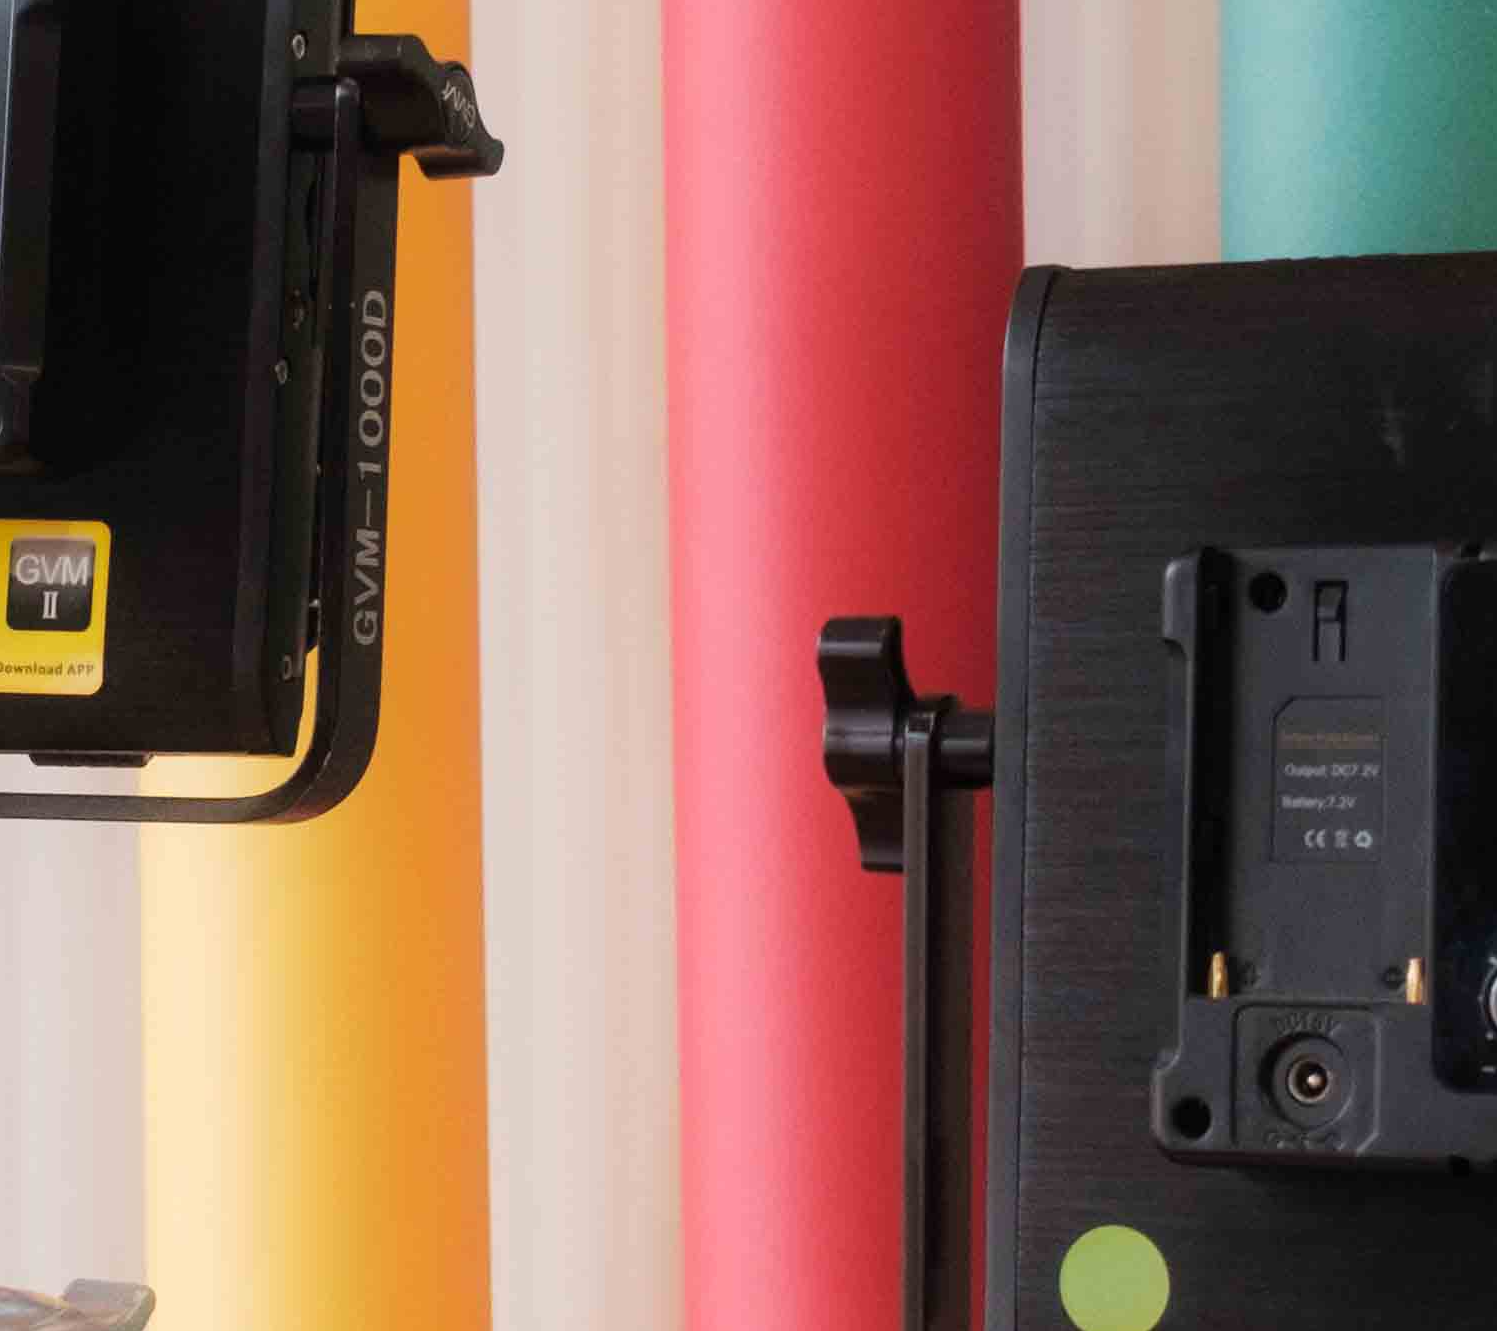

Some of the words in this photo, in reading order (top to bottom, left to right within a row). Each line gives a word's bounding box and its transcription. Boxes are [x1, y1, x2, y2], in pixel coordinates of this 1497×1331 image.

[352, 290, 388, 647] GVM-1000D
[15, 554, 90, 586] GVM
[67, 662, 96, 676] APP
